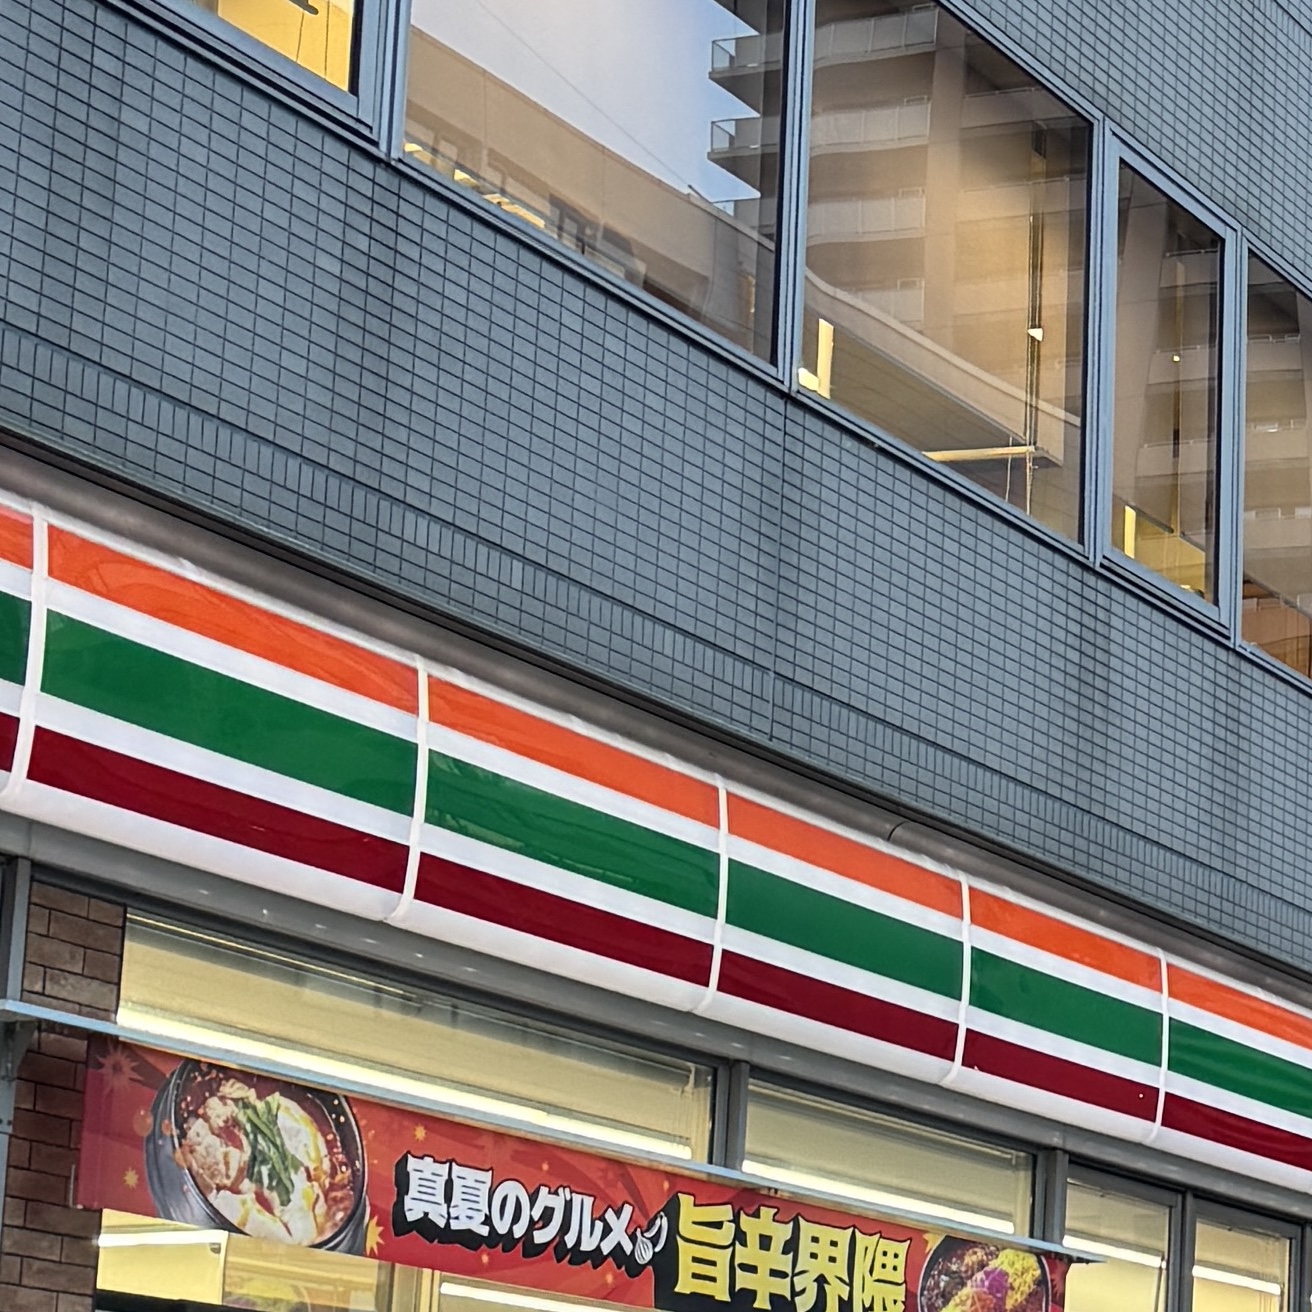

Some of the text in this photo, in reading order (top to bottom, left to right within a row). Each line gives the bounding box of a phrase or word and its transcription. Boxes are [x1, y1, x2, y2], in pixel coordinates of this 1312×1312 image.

[402, 1152, 634, 1258] 真夏のグルメ
